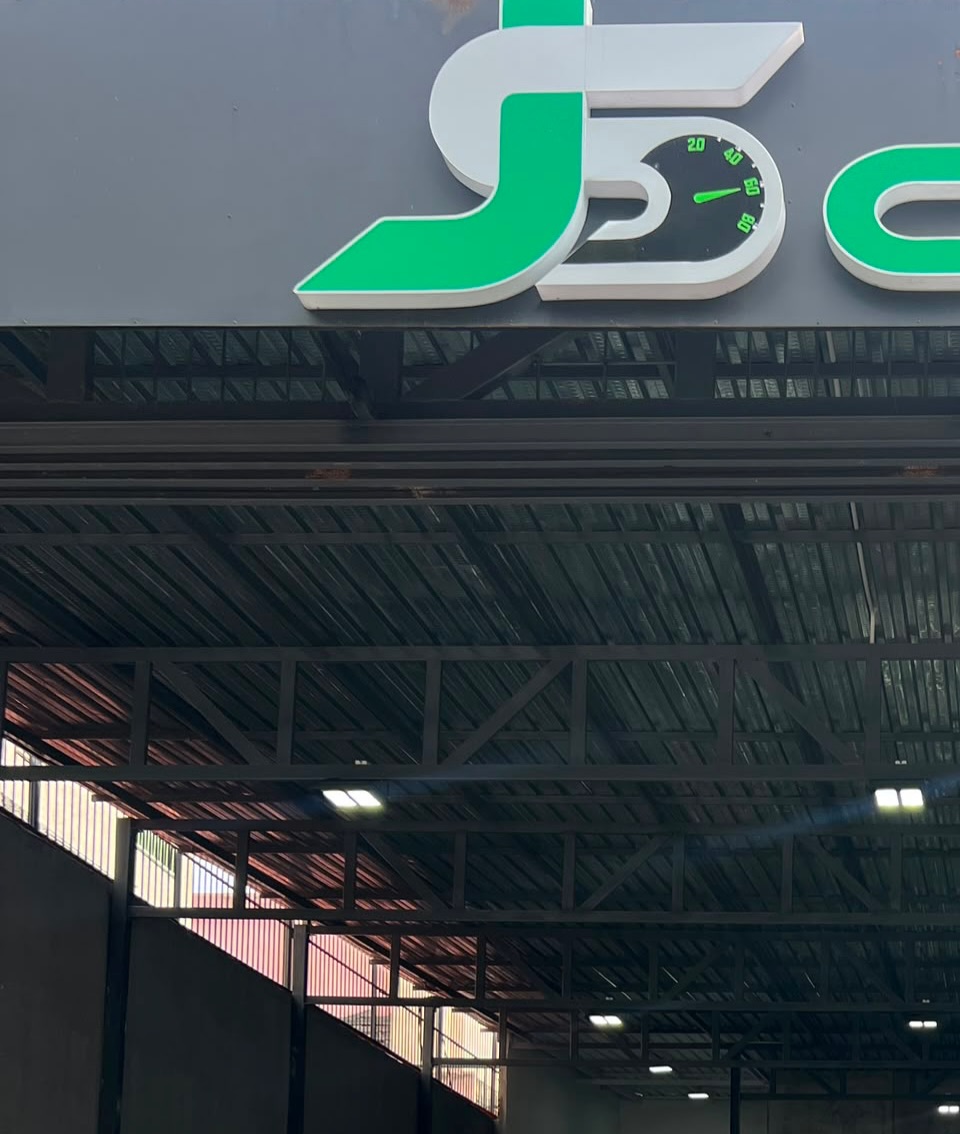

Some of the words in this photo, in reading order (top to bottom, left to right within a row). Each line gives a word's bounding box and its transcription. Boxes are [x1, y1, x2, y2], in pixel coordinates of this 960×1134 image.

[687, 137, 706, 153] 20
[723, 147, 744, 166] 40
[743, 177, 761, 196] 60
[736, 212, 756, 234] 80
